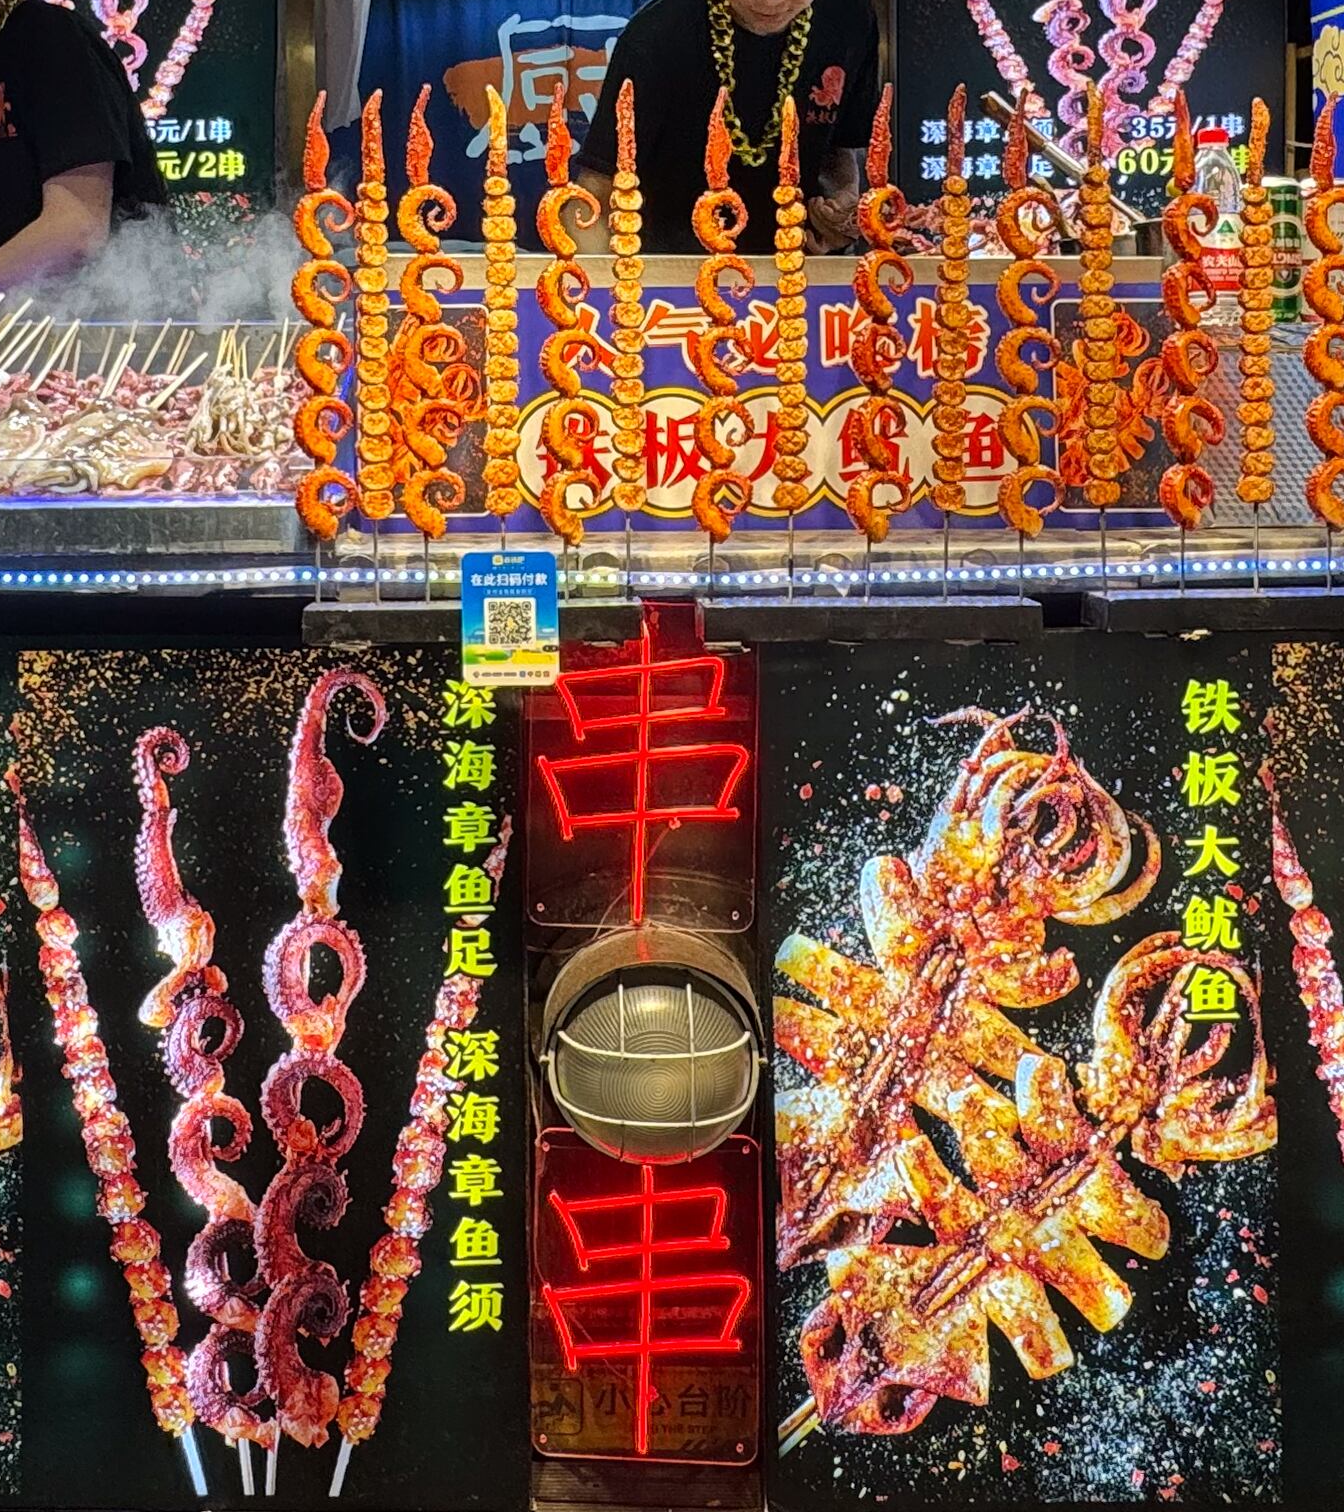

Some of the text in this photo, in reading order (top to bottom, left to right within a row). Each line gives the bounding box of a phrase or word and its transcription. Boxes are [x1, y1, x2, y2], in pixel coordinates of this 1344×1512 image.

[442, 679, 497, 978] 深海章鱼足
[1180, 678, 1243, 1023] 铁板大鱿鱼
[444, 1030, 504, 1333] 深海章鱼须
